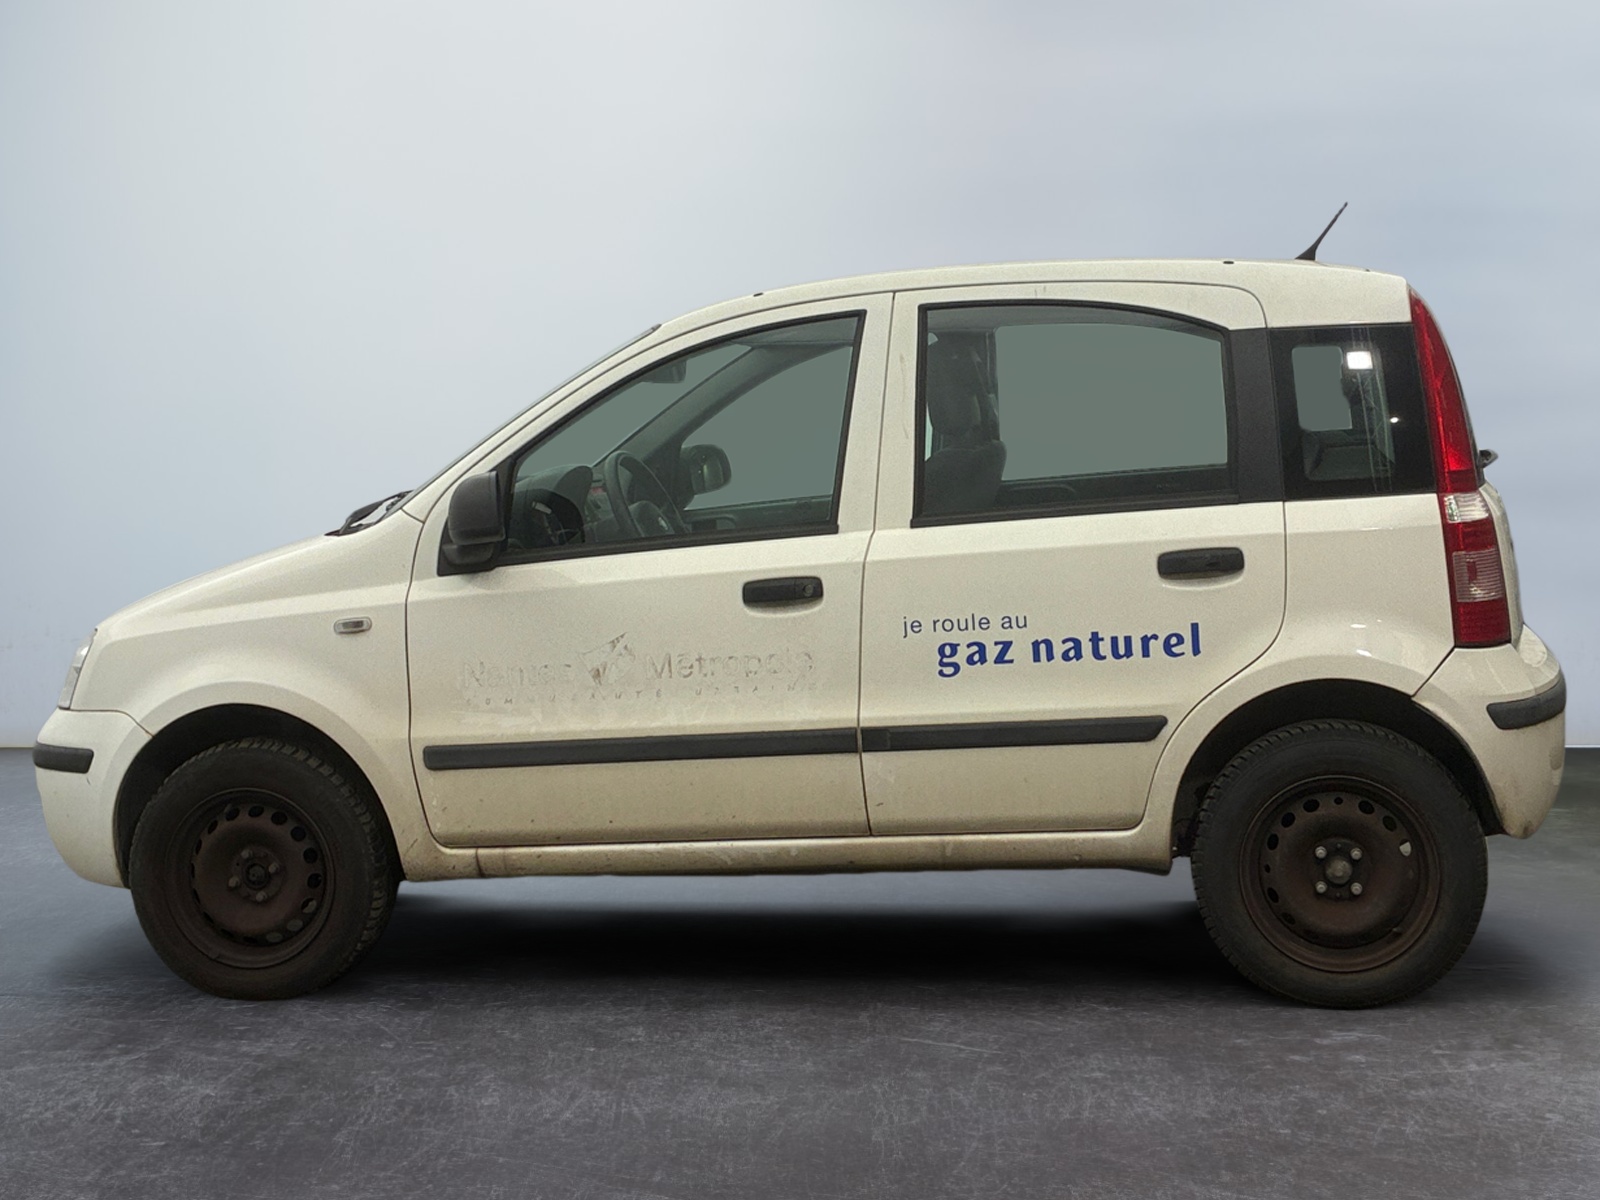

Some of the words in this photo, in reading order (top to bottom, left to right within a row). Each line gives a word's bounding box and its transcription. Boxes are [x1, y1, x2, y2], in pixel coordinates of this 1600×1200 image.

[902, 615, 923, 639] je
[932, 612, 991, 633] roule
[1000, 614, 1028, 630] au
[937, 639, 1015, 678] gaz
[1031, 622, 1202, 664] naturel
